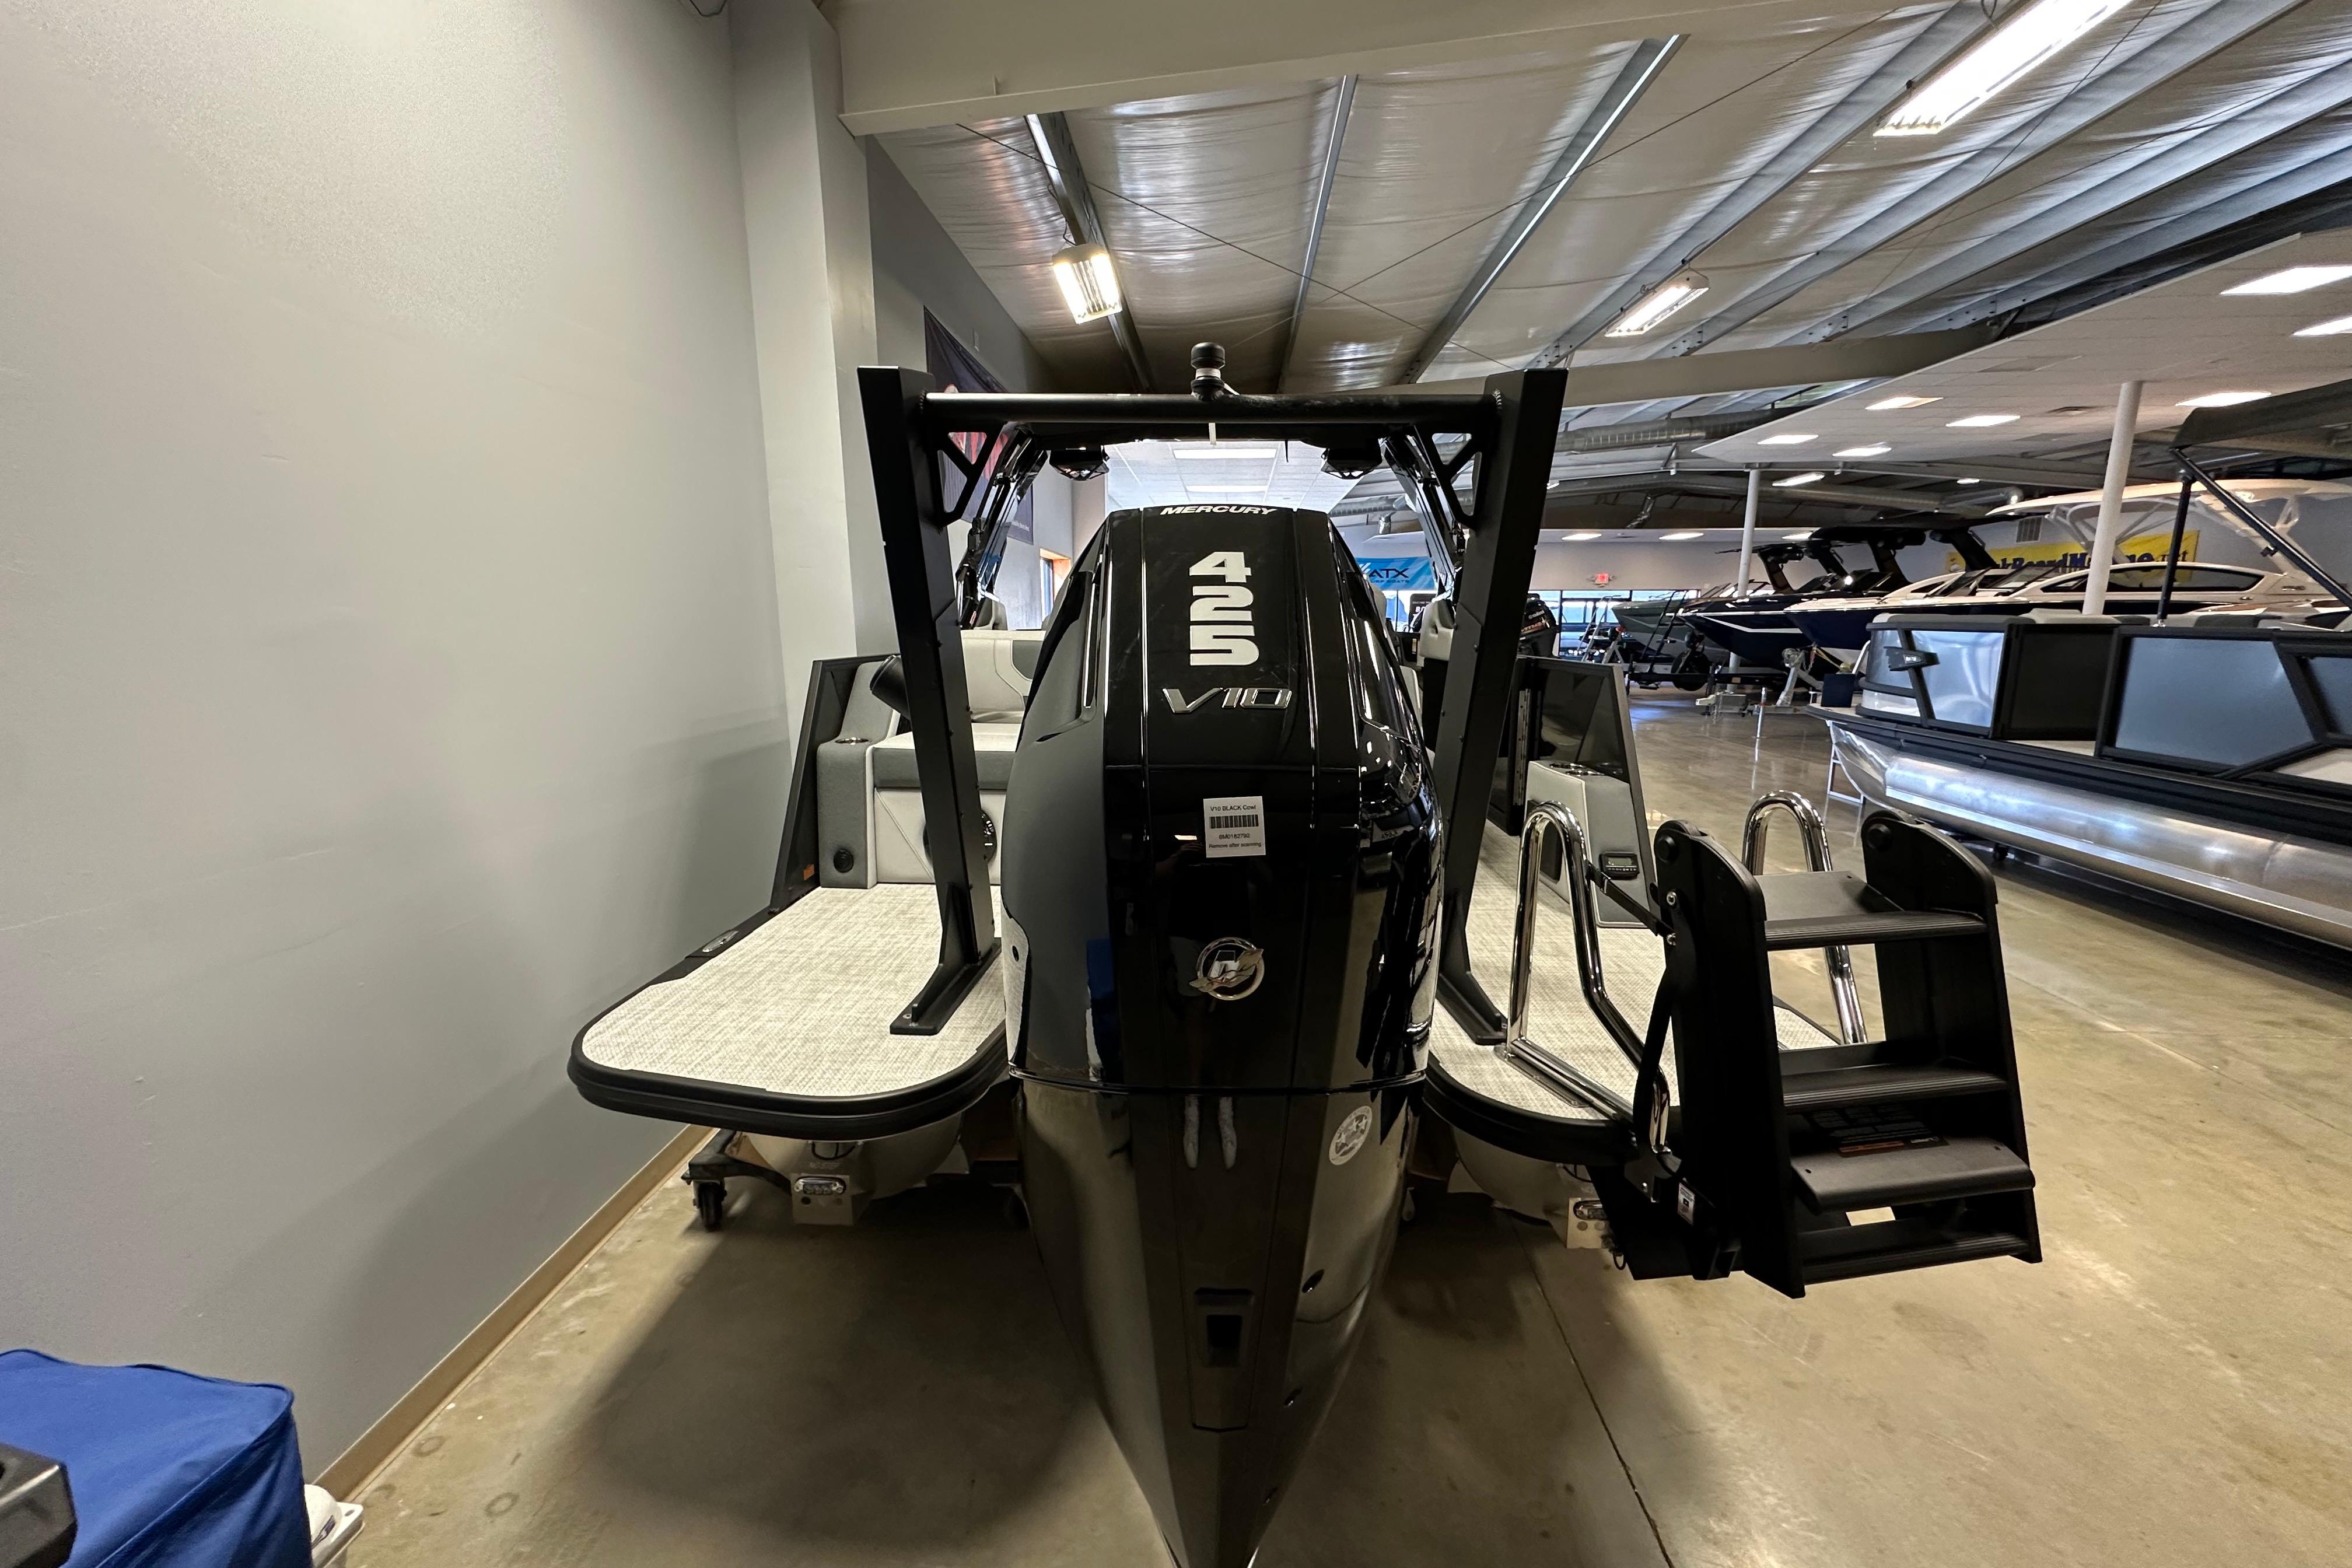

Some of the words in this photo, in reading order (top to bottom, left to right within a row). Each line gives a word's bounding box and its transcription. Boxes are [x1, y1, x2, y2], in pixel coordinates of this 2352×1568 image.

[1160, 505, 1277, 515] MERCURY
[1368, 568, 1409, 578] ATX
[1188, 551, 1259, 666] 425
[1162, 687, 1293, 713] V10
